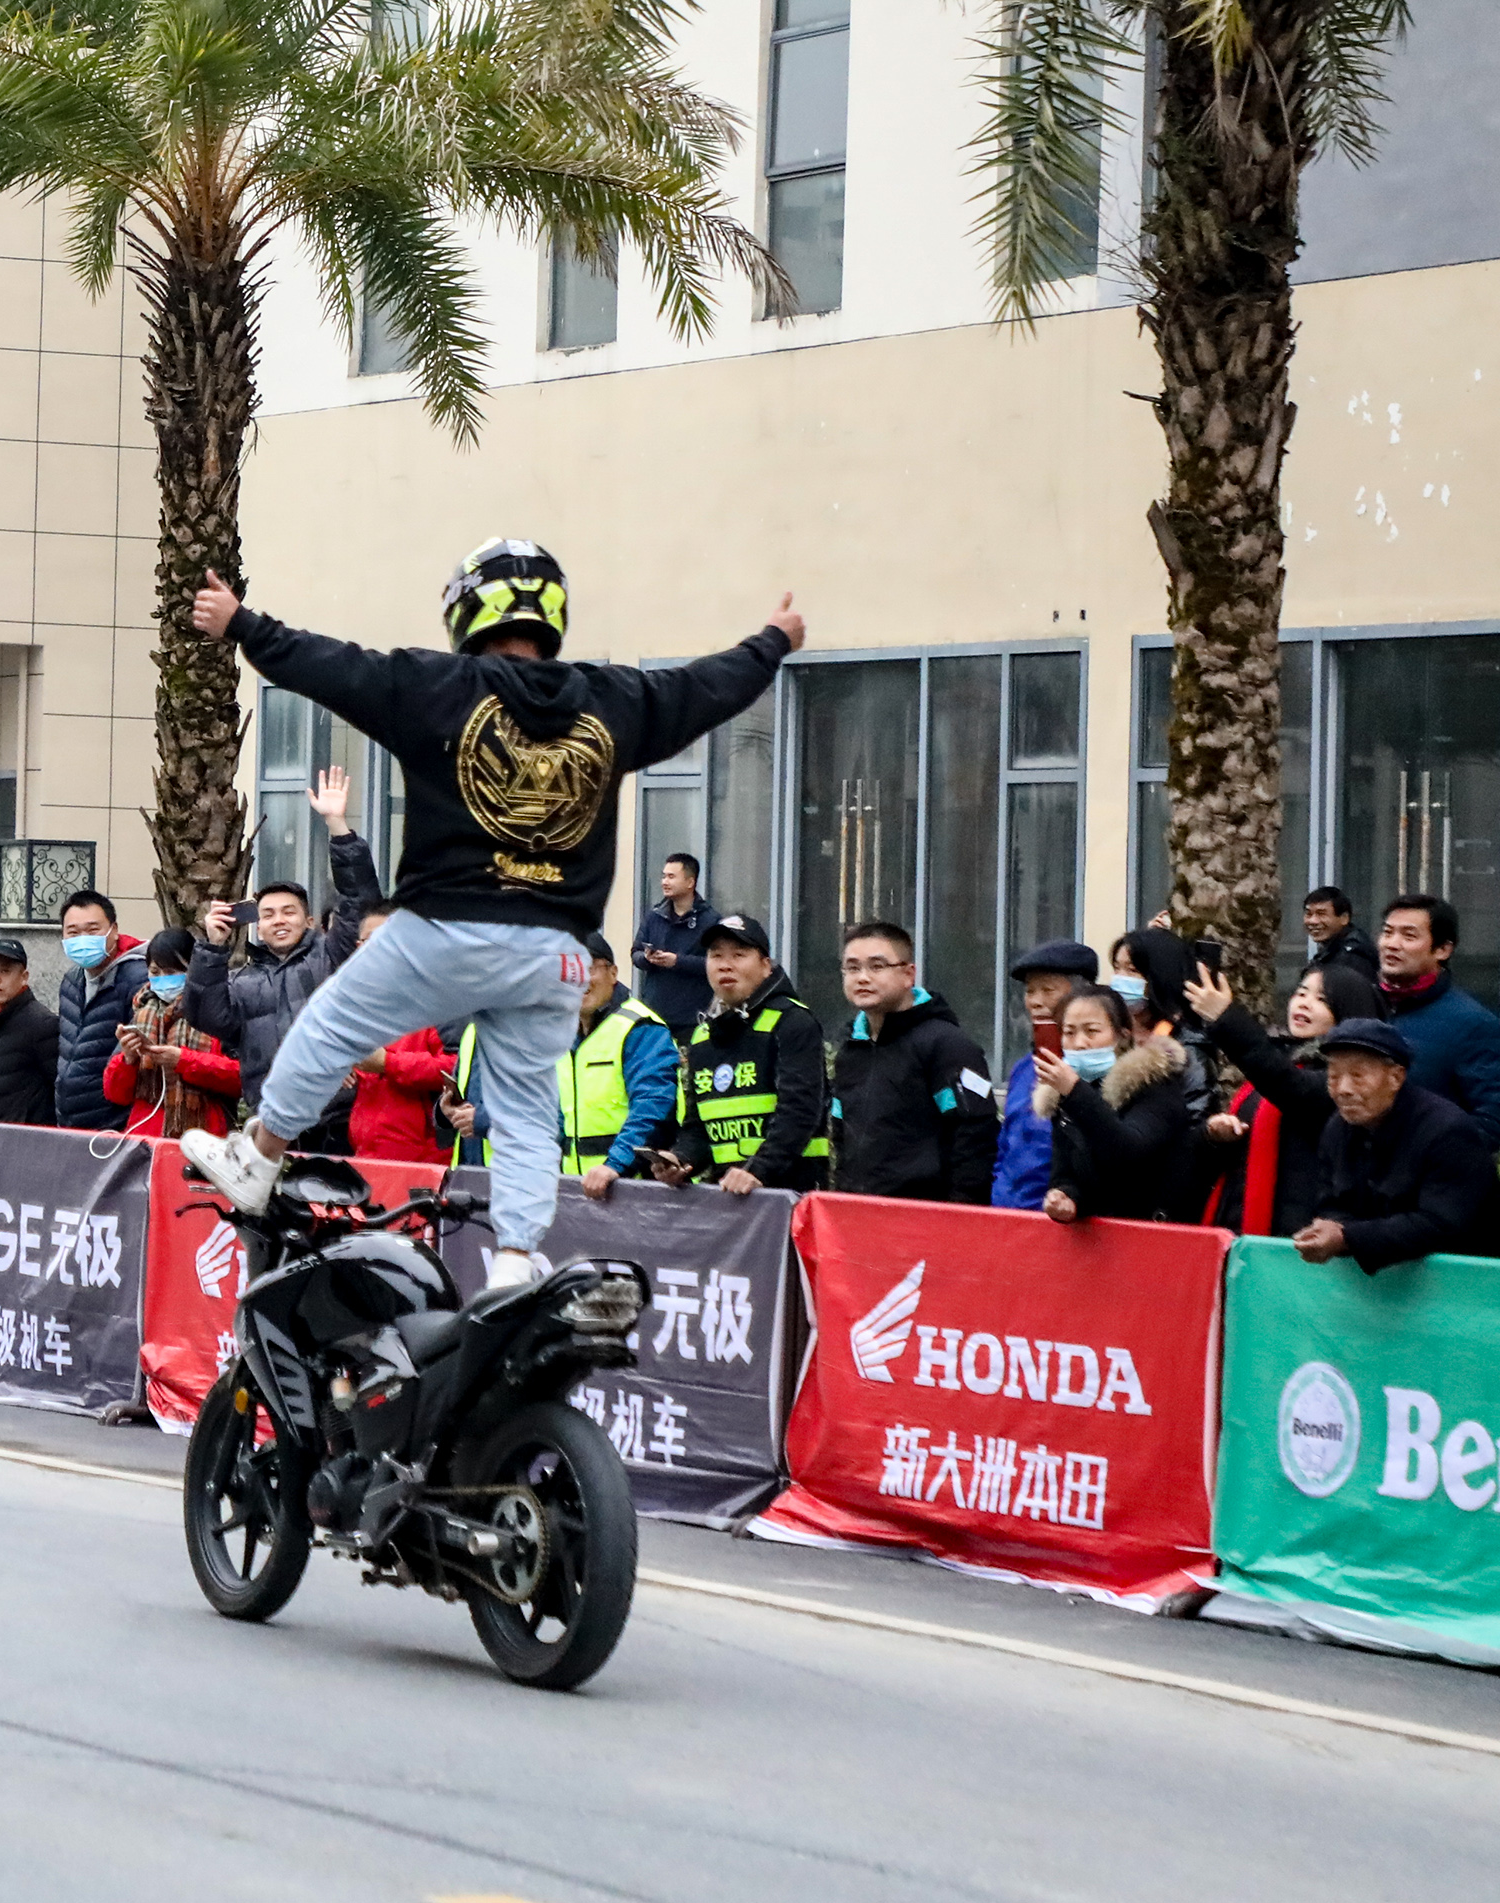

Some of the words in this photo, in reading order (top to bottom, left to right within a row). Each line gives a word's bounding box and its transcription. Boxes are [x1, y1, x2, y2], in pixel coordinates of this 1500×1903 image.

[694, 1067, 714, 1095] 安
[735, 1060, 757, 1088] 保
[45, 1206, 122, 1289] 无极
[651, 1266, 754, 1365] 无极
[913, 1325, 1153, 1416] HONDA
[569, 1383, 688, 1468] 极机车
[1292, 1417, 1344, 1442] Benelli
[1376, 1385, 1500, 1516] Be
[878, 1423, 1109, 1531] 新大洲本田
